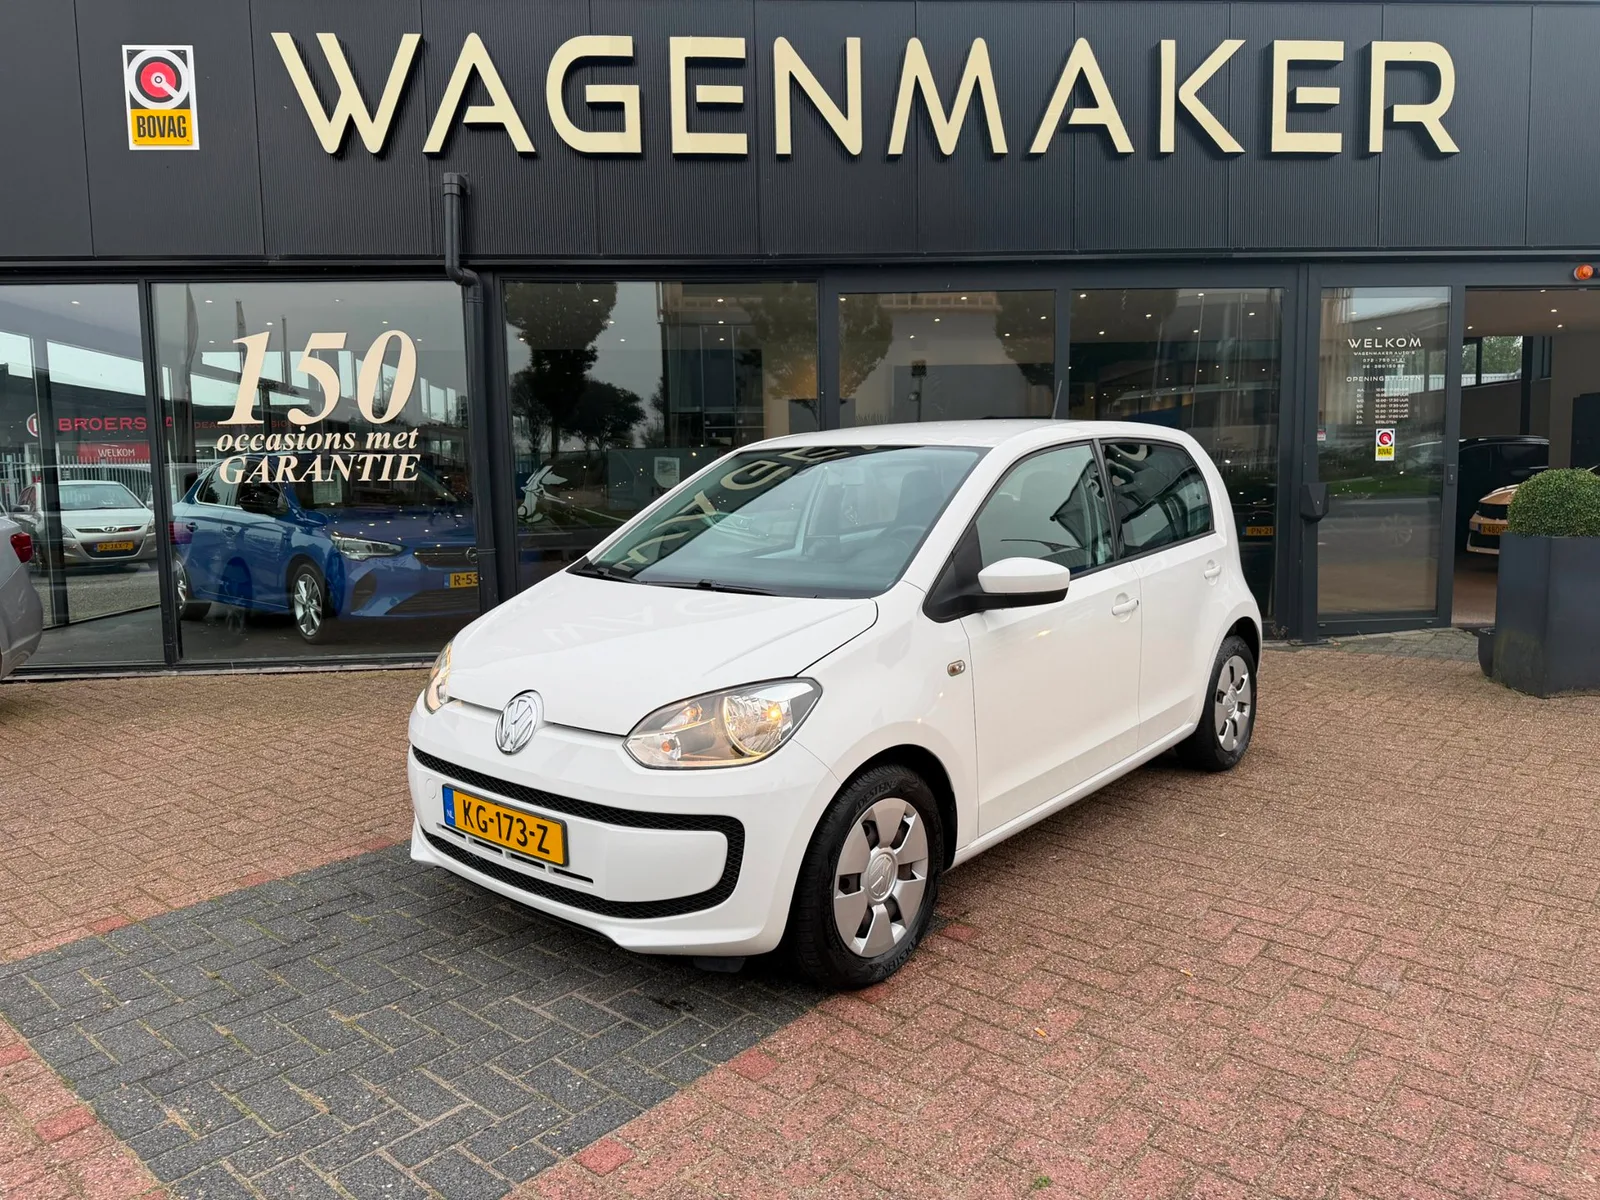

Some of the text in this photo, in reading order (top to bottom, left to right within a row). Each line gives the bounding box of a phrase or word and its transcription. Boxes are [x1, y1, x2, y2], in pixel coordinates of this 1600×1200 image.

[270, 32, 1460, 155] WAGENMAKER
[136, 113, 187, 140] BOVAG
[1347, 337, 1422, 348] WELKOM
[217, 330, 418, 425] 150
[216, 425, 356, 452] occasions
[366, 427, 419, 449] met
[1377, 447, 1393, 456] BOVAG
[97, 448, 135, 458] WELKOM
[218, 453, 421, 484] GARANTIE
[454, 573, 479, 586] R-53
[462, 799, 550, 855] KG-173-Z
